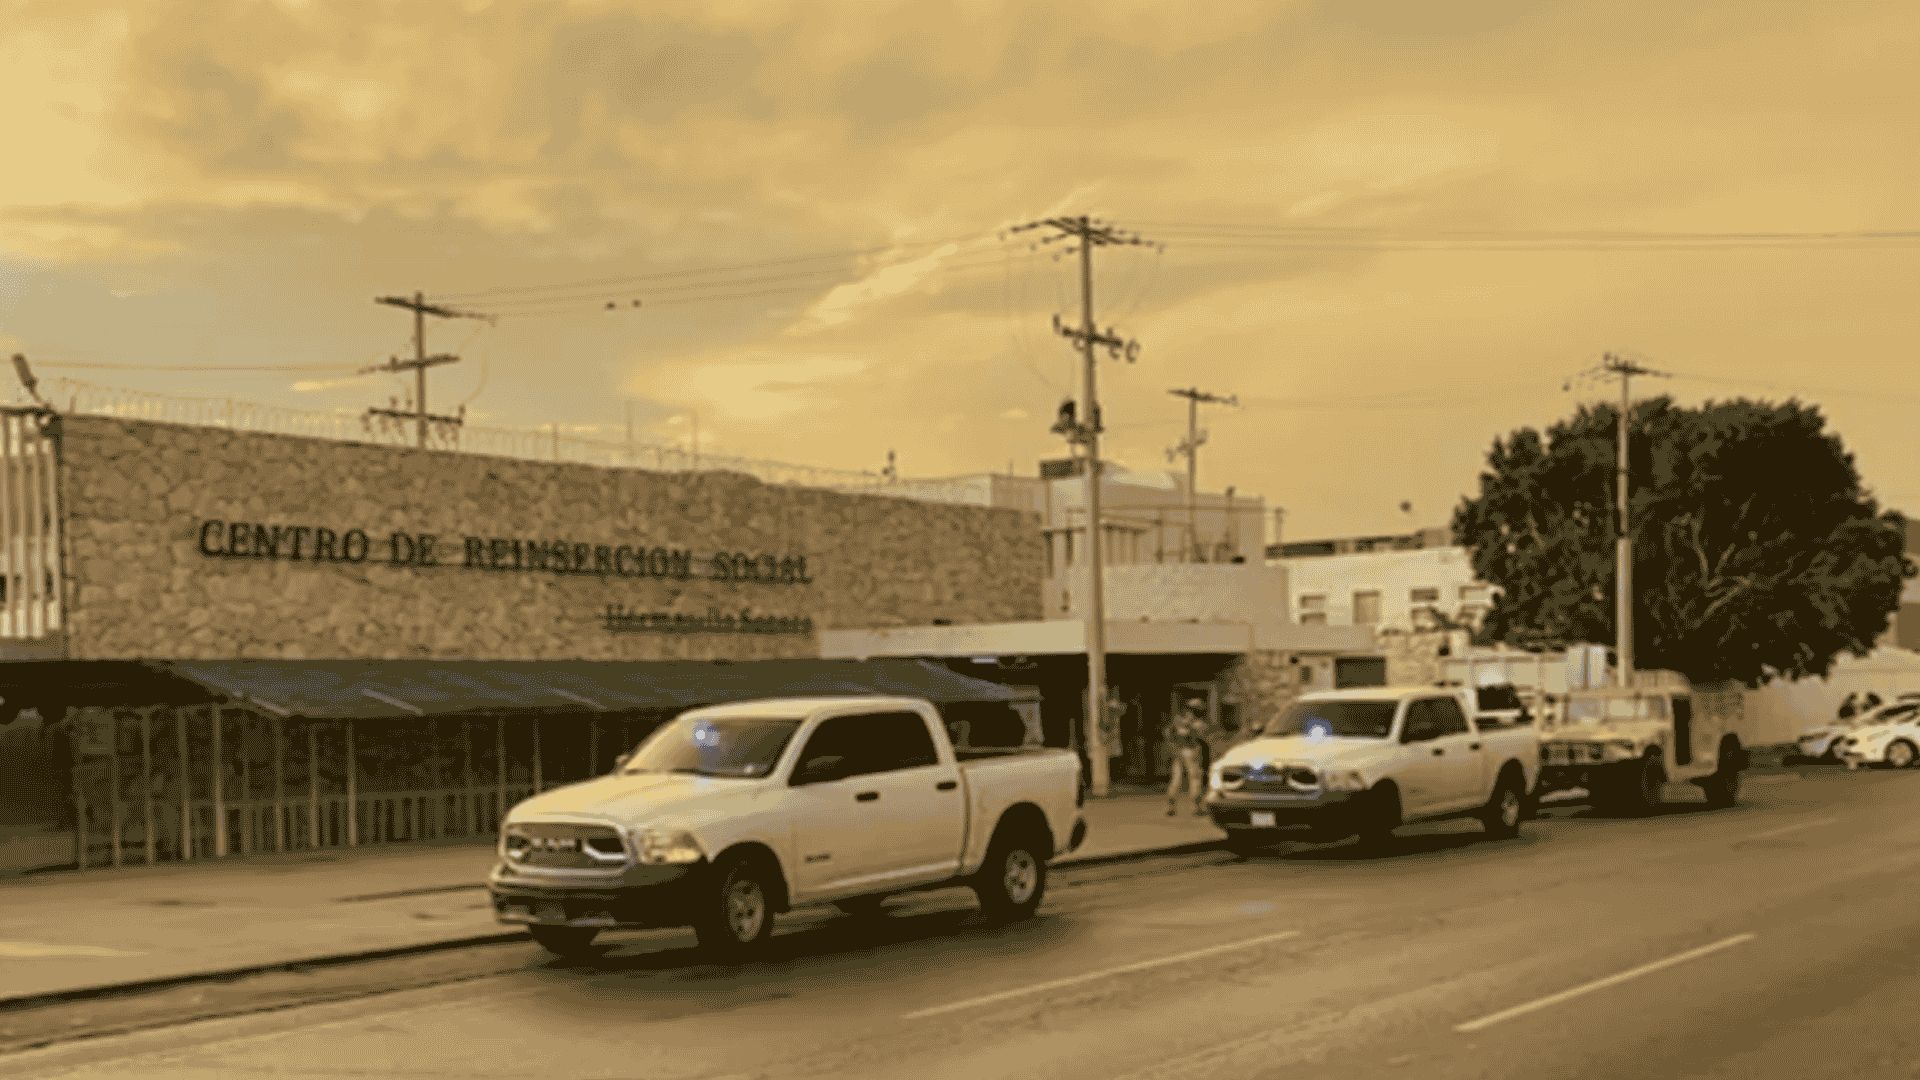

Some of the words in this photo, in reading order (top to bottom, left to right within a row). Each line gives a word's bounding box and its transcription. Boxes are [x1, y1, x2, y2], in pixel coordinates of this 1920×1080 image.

[200, 519, 370, 563] CENTRO
[391, 529, 438, 566] DE
[464, 535, 692, 579] REINSERCION
[711, 551, 813, 584] SOCIAL
